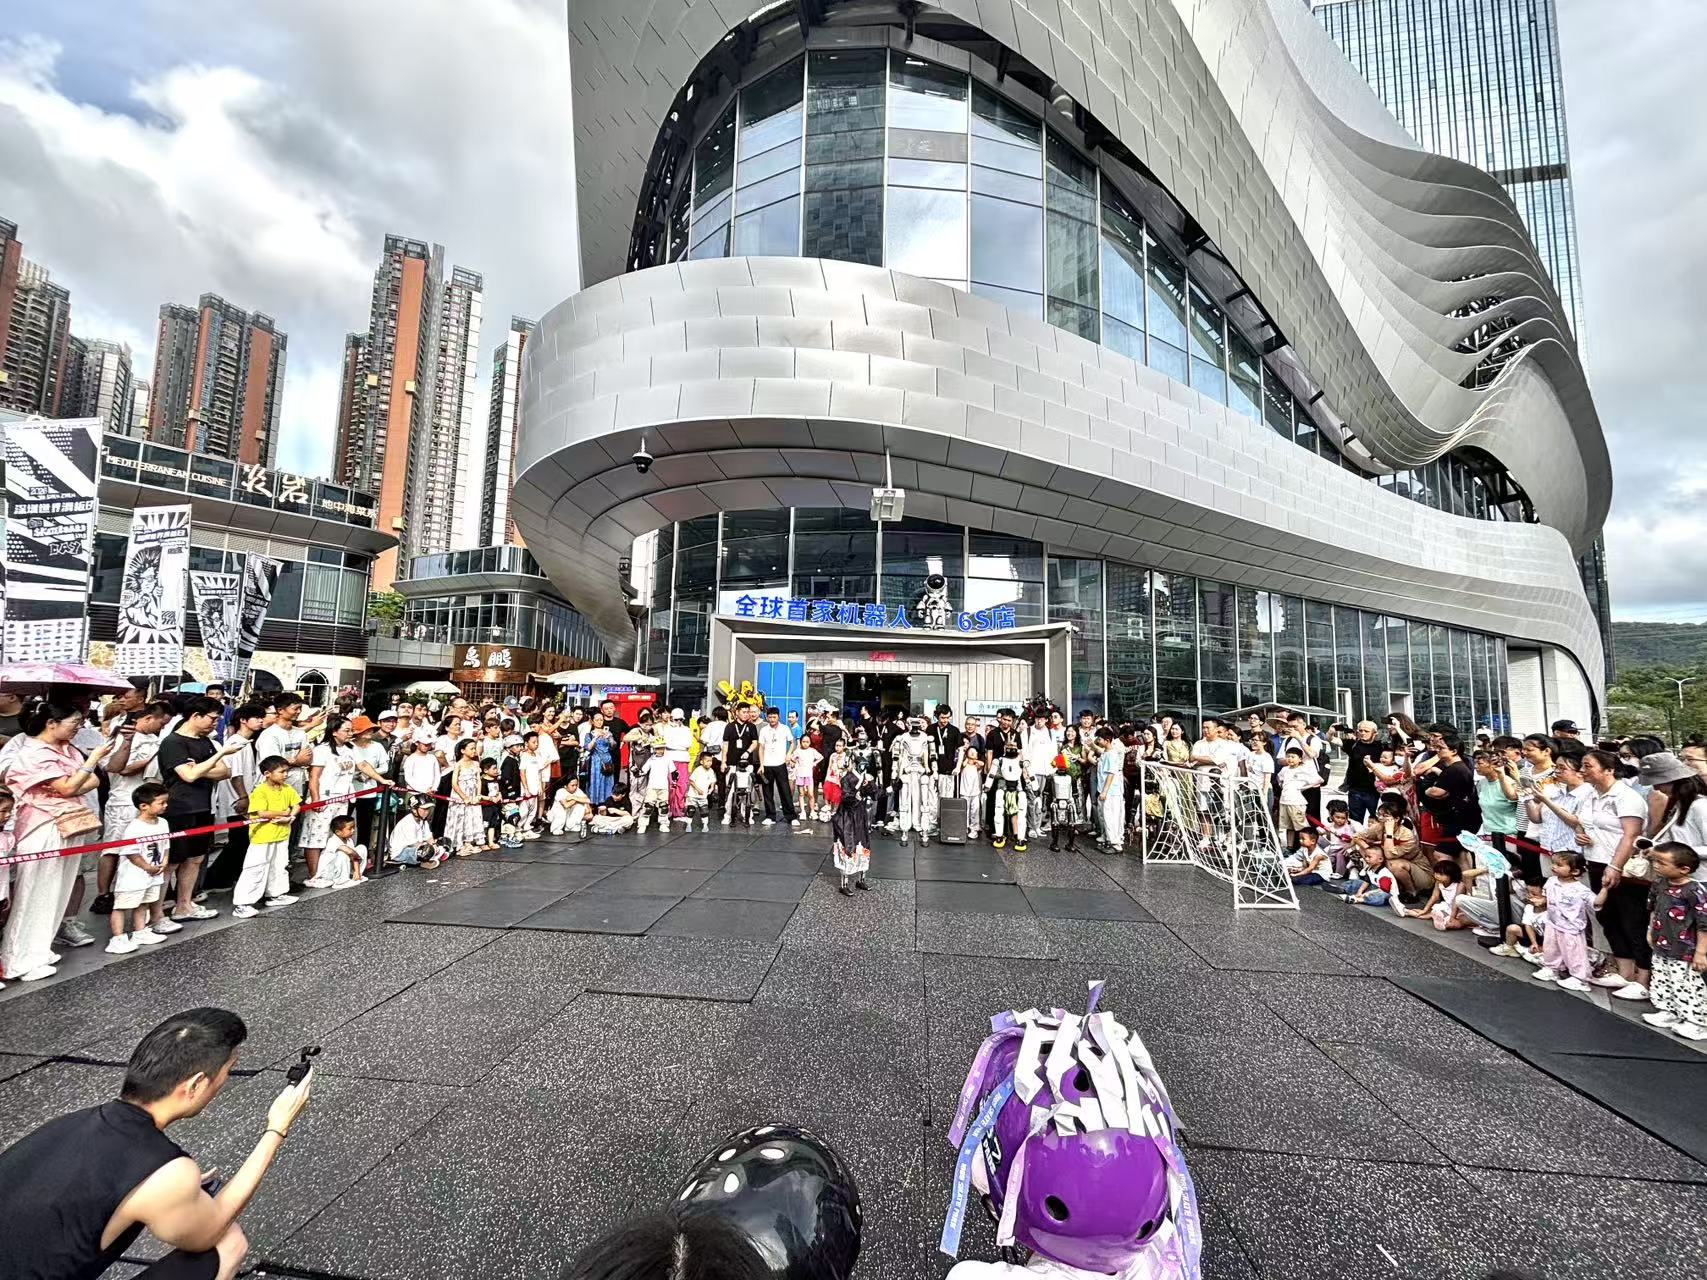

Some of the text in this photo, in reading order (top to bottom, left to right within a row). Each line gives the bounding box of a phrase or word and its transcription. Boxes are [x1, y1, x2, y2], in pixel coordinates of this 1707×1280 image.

[105, 455, 228, 487] MEDITERRANEAN CUISINE
[735, 594, 1017, 632] 全球首家机器人 6S店
